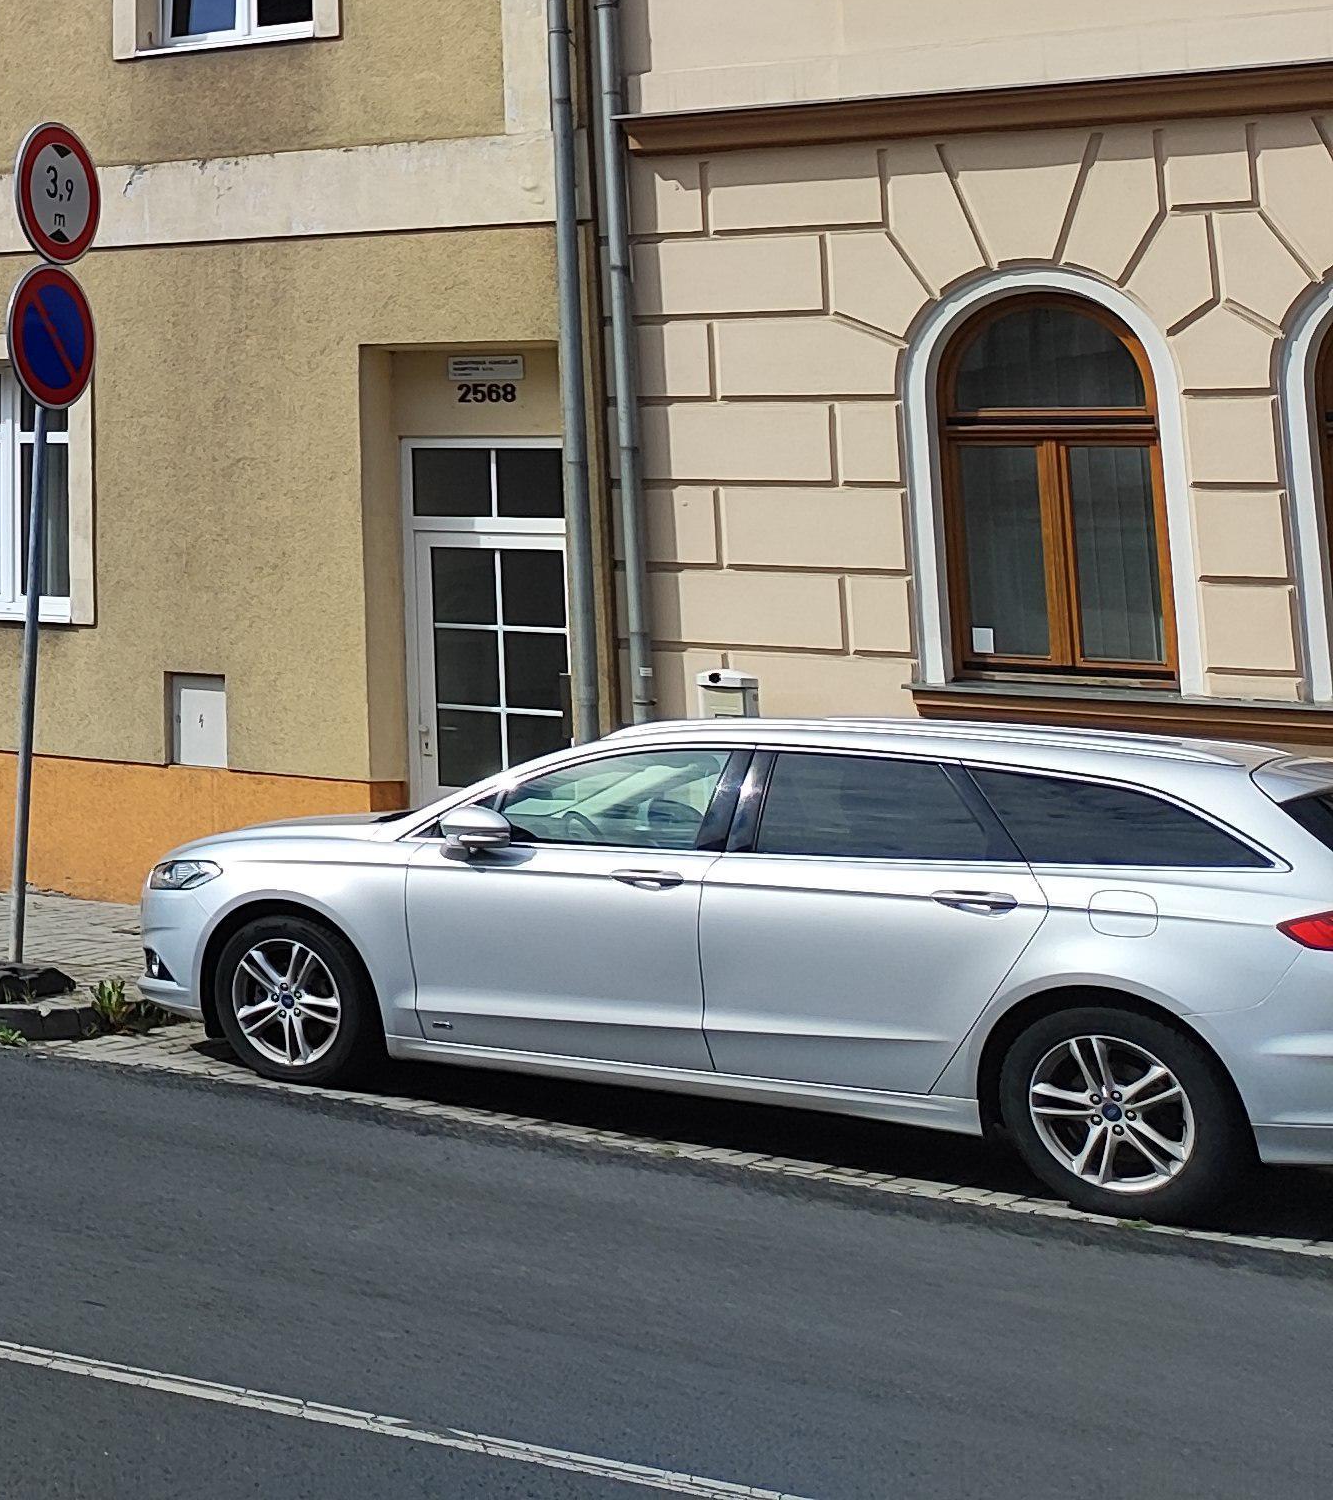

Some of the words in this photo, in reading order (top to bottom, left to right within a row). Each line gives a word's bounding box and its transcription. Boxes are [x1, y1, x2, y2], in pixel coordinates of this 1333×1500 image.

[45, 165, 74, 202] 3,9
[53, 212, 66, 228] m
[457, 383, 517, 403] 2568
